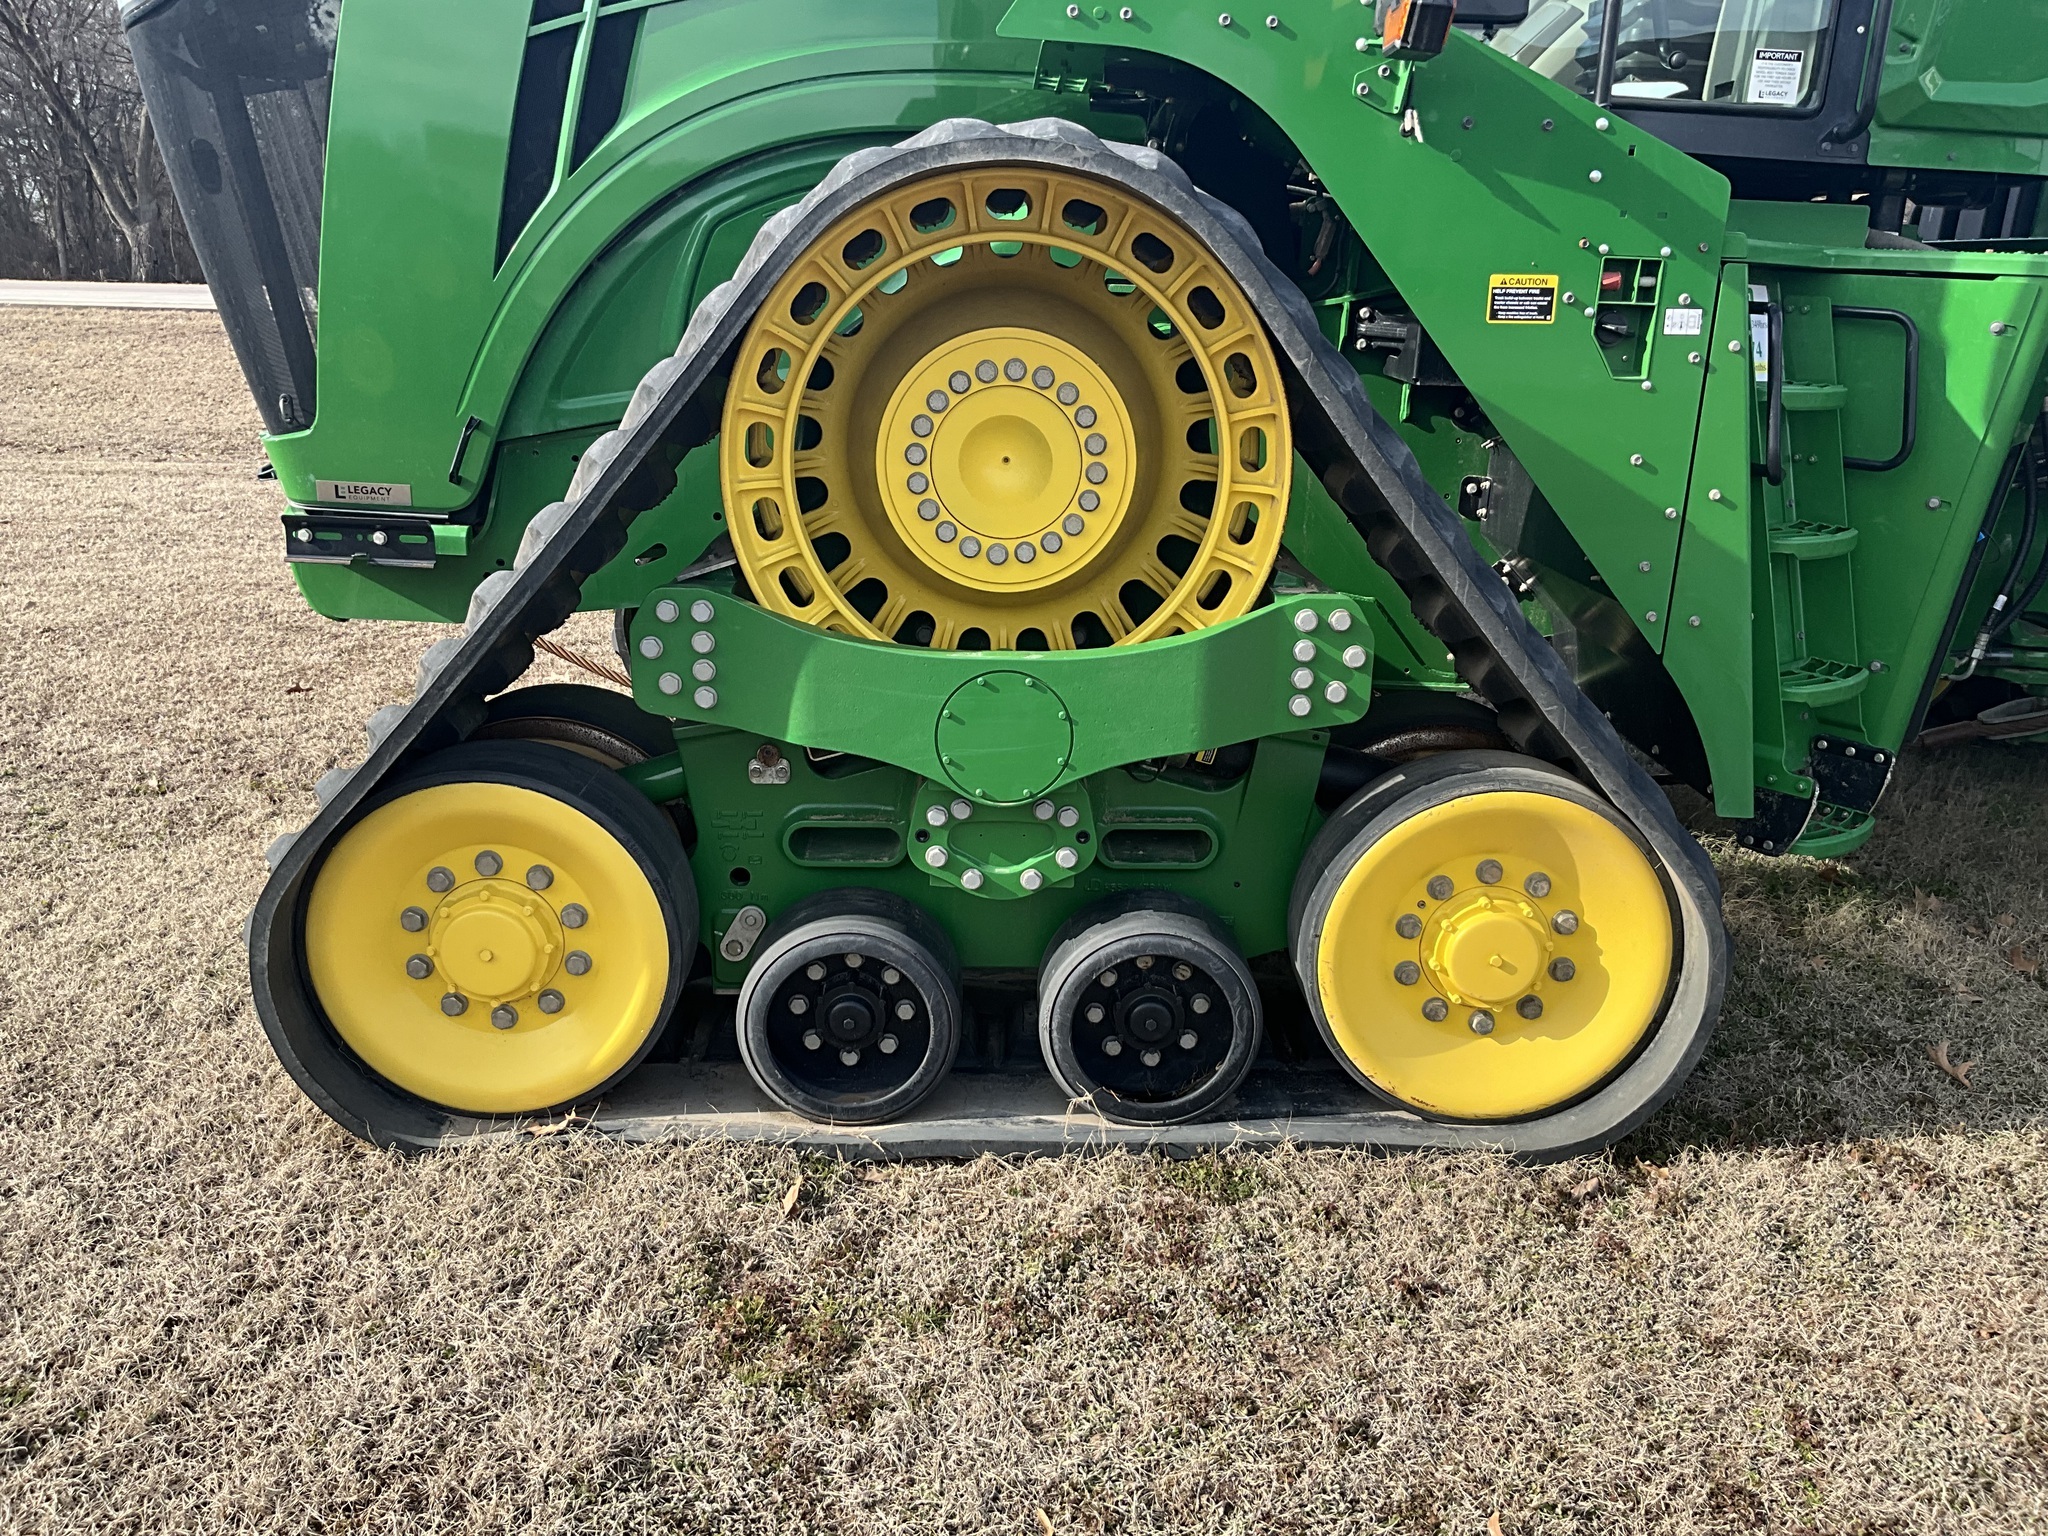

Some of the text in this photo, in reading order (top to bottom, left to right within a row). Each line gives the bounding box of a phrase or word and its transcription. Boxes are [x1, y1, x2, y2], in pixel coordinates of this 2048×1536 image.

[1759, 51, 1798, 60] IMPORTANT
[1508, 277, 1548, 286] CAUTION
[347, 485, 392, 496] LEGACY
